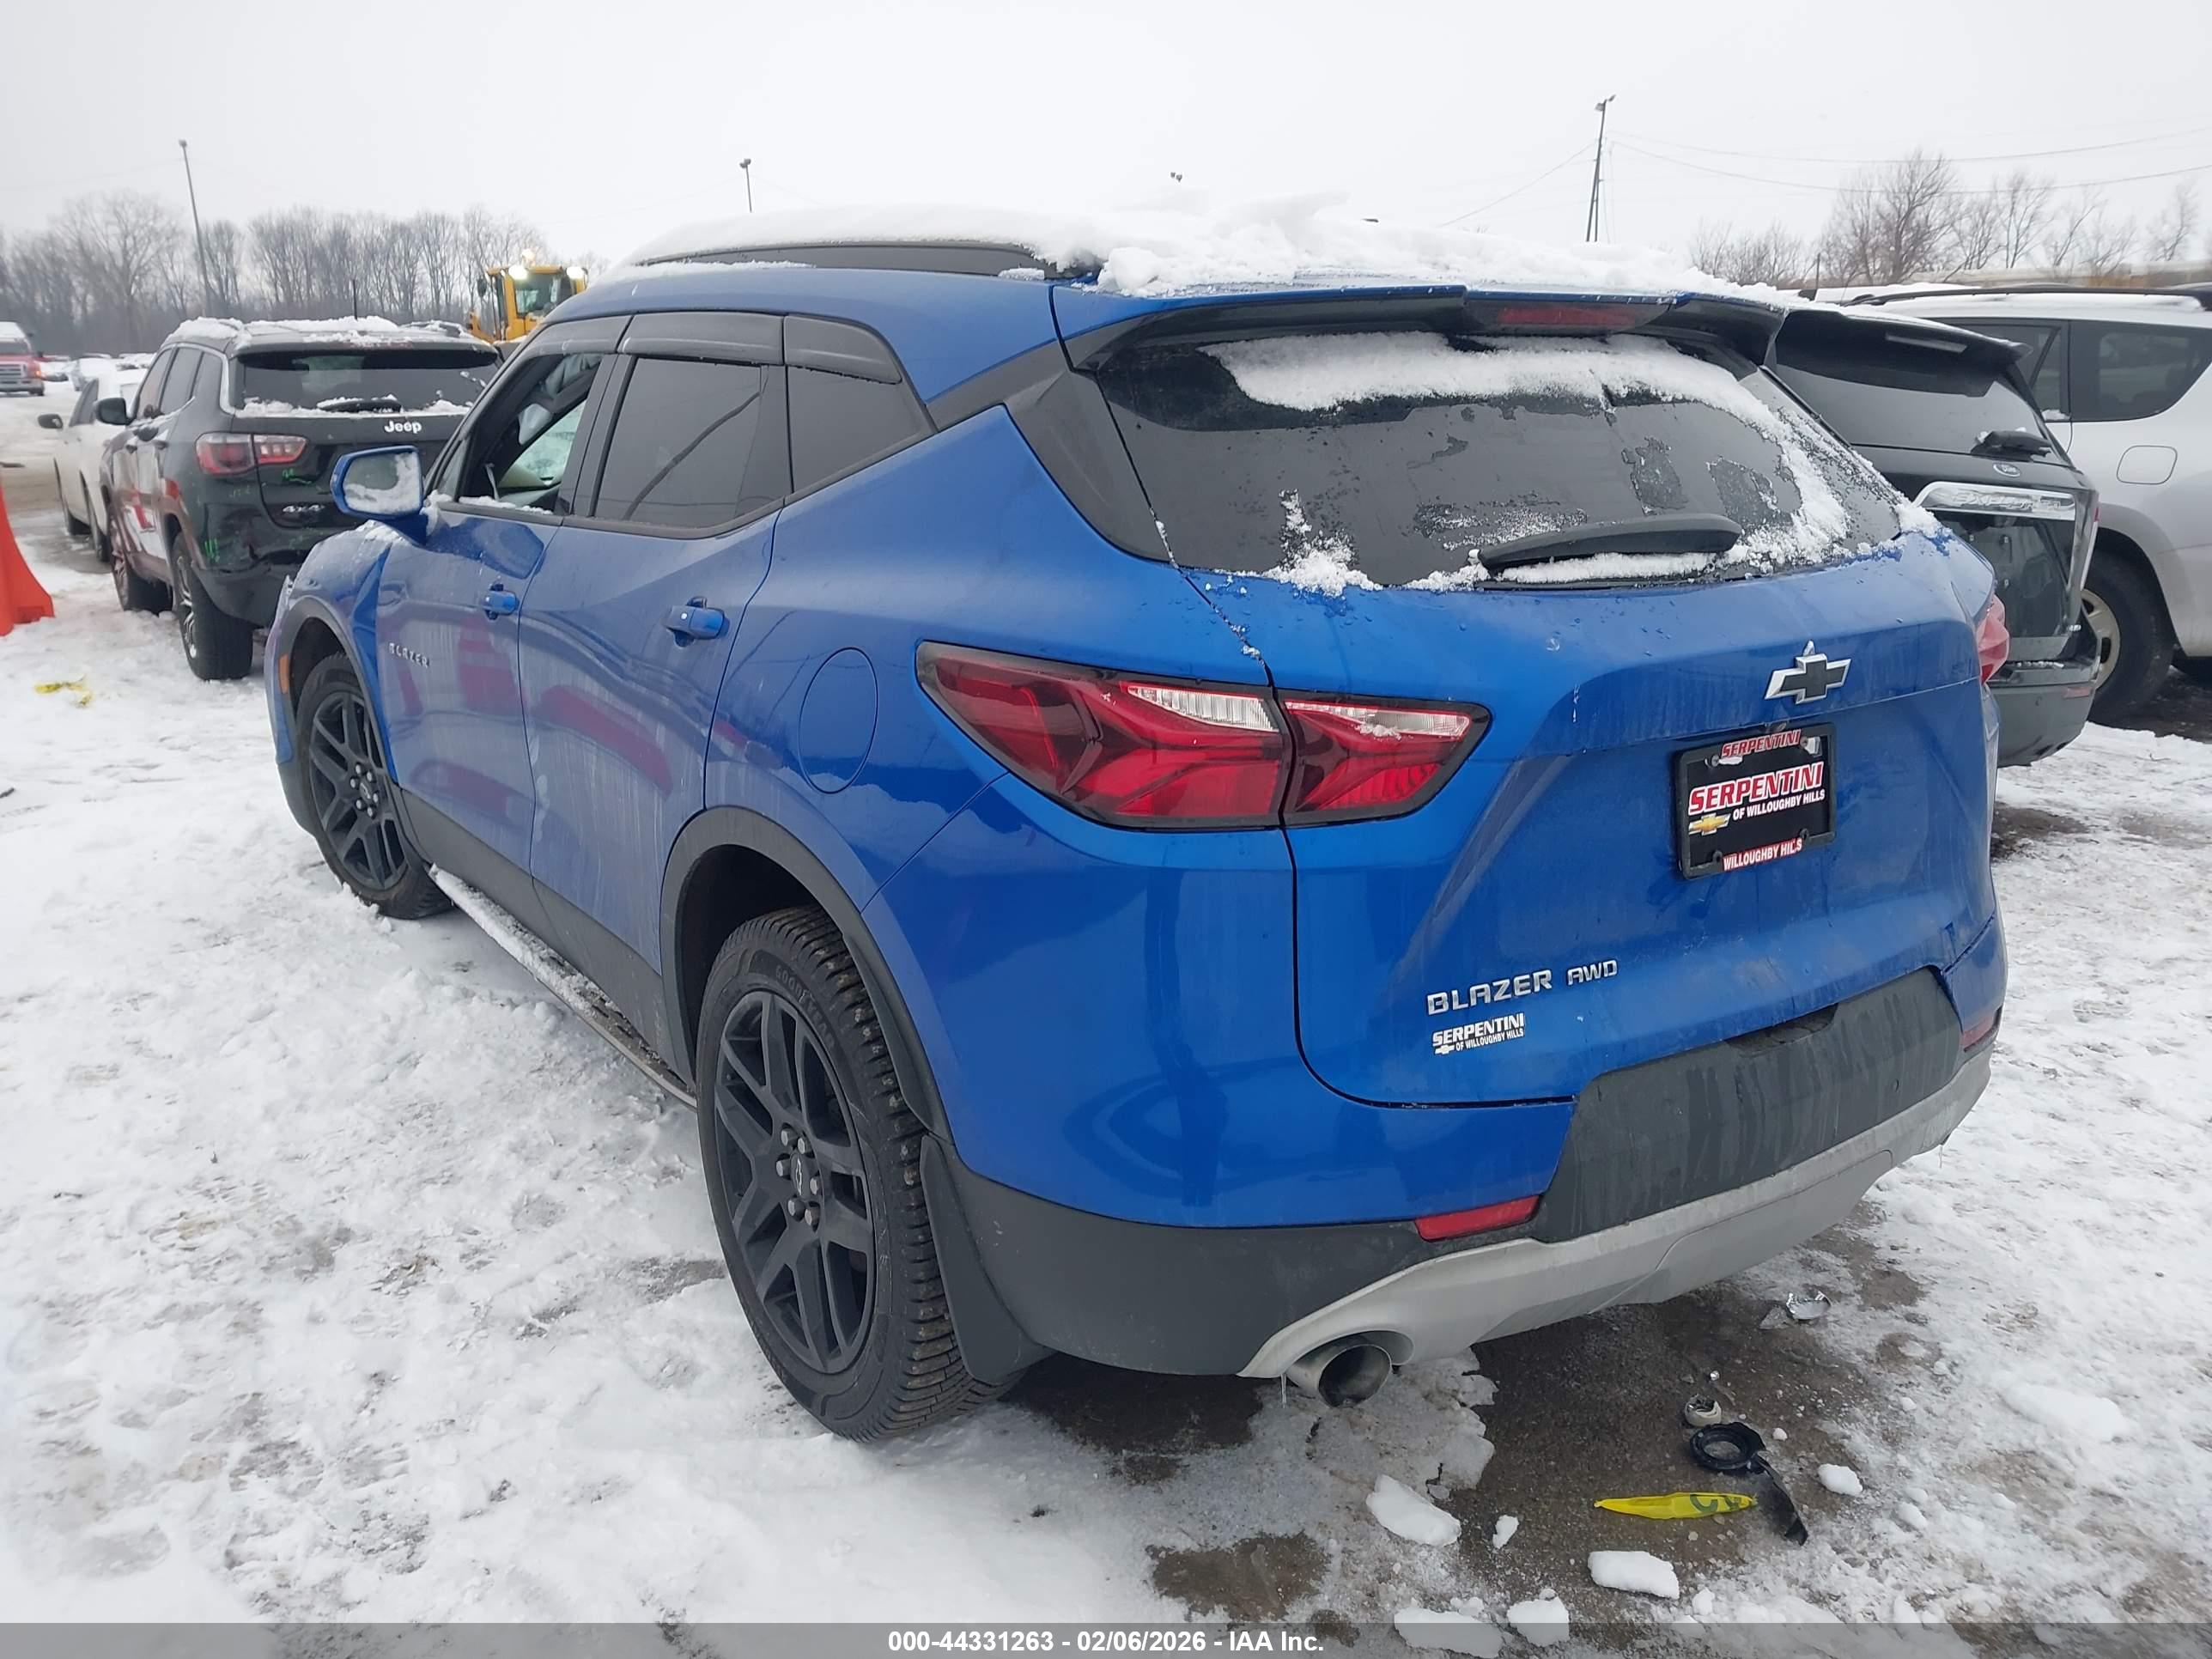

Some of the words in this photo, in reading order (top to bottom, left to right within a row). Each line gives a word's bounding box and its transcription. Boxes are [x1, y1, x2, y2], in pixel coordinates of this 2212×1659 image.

[384, 420, 422, 434] Jeep
[1722, 730, 1801, 757] SERPENTINI
[1688, 763, 1824, 815] SERPENTINI
[1733, 807, 1746, 820] OF
[1747, 797, 1802, 817] WILLOUGHBY
[1803, 789, 1825, 805] HILLS
[1723, 846, 1778, 871] WILLOUGHBY
[1427, 969, 1552, 1015] BLAZER
[1567, 959, 1618, 985] AWD
[1432, 1012, 1525, 1047] SERPENTINI
[1455, 1042, 1465, 1052] OF
[1465, 1034, 1505, 1049] WILLOUGHBY
[1506, 1028, 1524, 1040] HILLS
